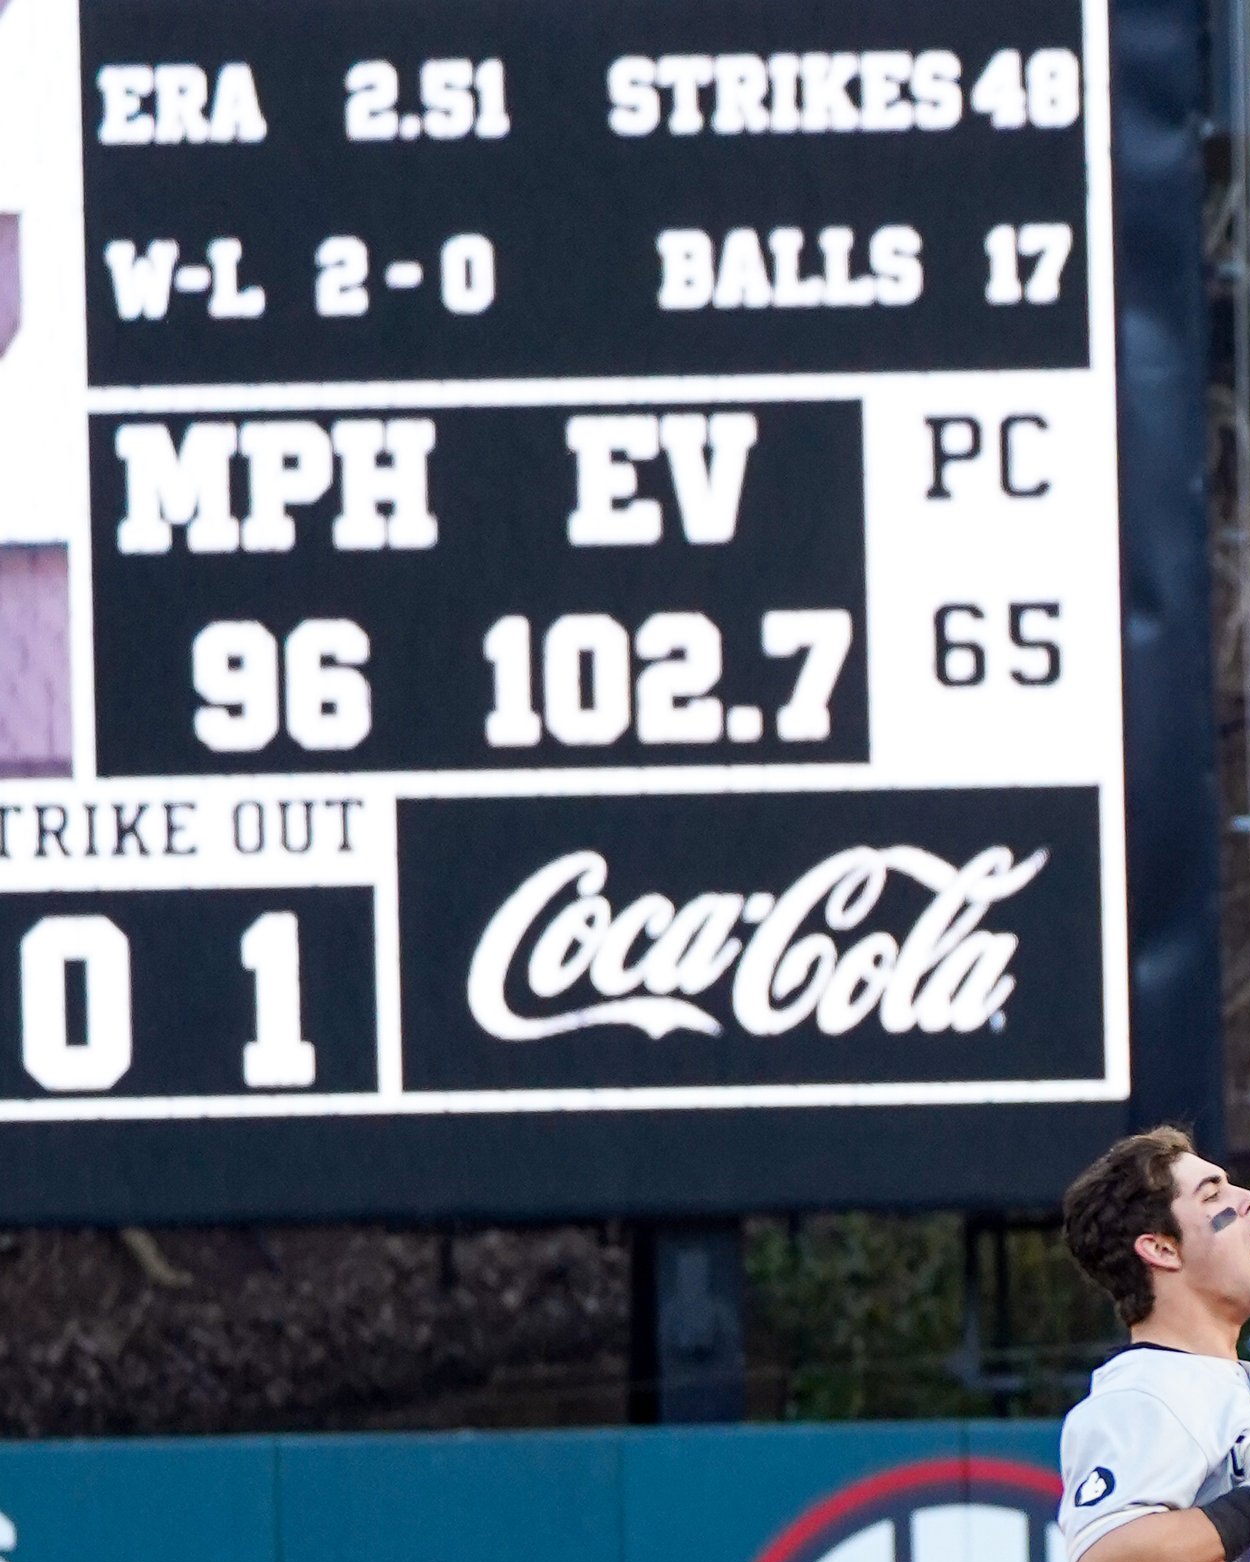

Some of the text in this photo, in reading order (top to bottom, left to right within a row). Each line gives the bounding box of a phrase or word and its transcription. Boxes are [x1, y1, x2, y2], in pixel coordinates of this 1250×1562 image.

[97, 59, 511, 145] ERA 2.51
[606, 48, 1080, 136] STRIKES 48
[104, 237, 266, 320] W-L
[656, 222, 1073, 310] BALLS 17
[114, 413, 758, 555] MPH EV
[924, 414, 1051, 501] PC
[192, 608, 853, 753] 96 102.7
[933, 601, 1062, 688] 65
[232, 798, 363, 853] OUT
[468, 845, 1049, 1041] Coca-Cola
[19, 911, 316, 1092] 0 1
